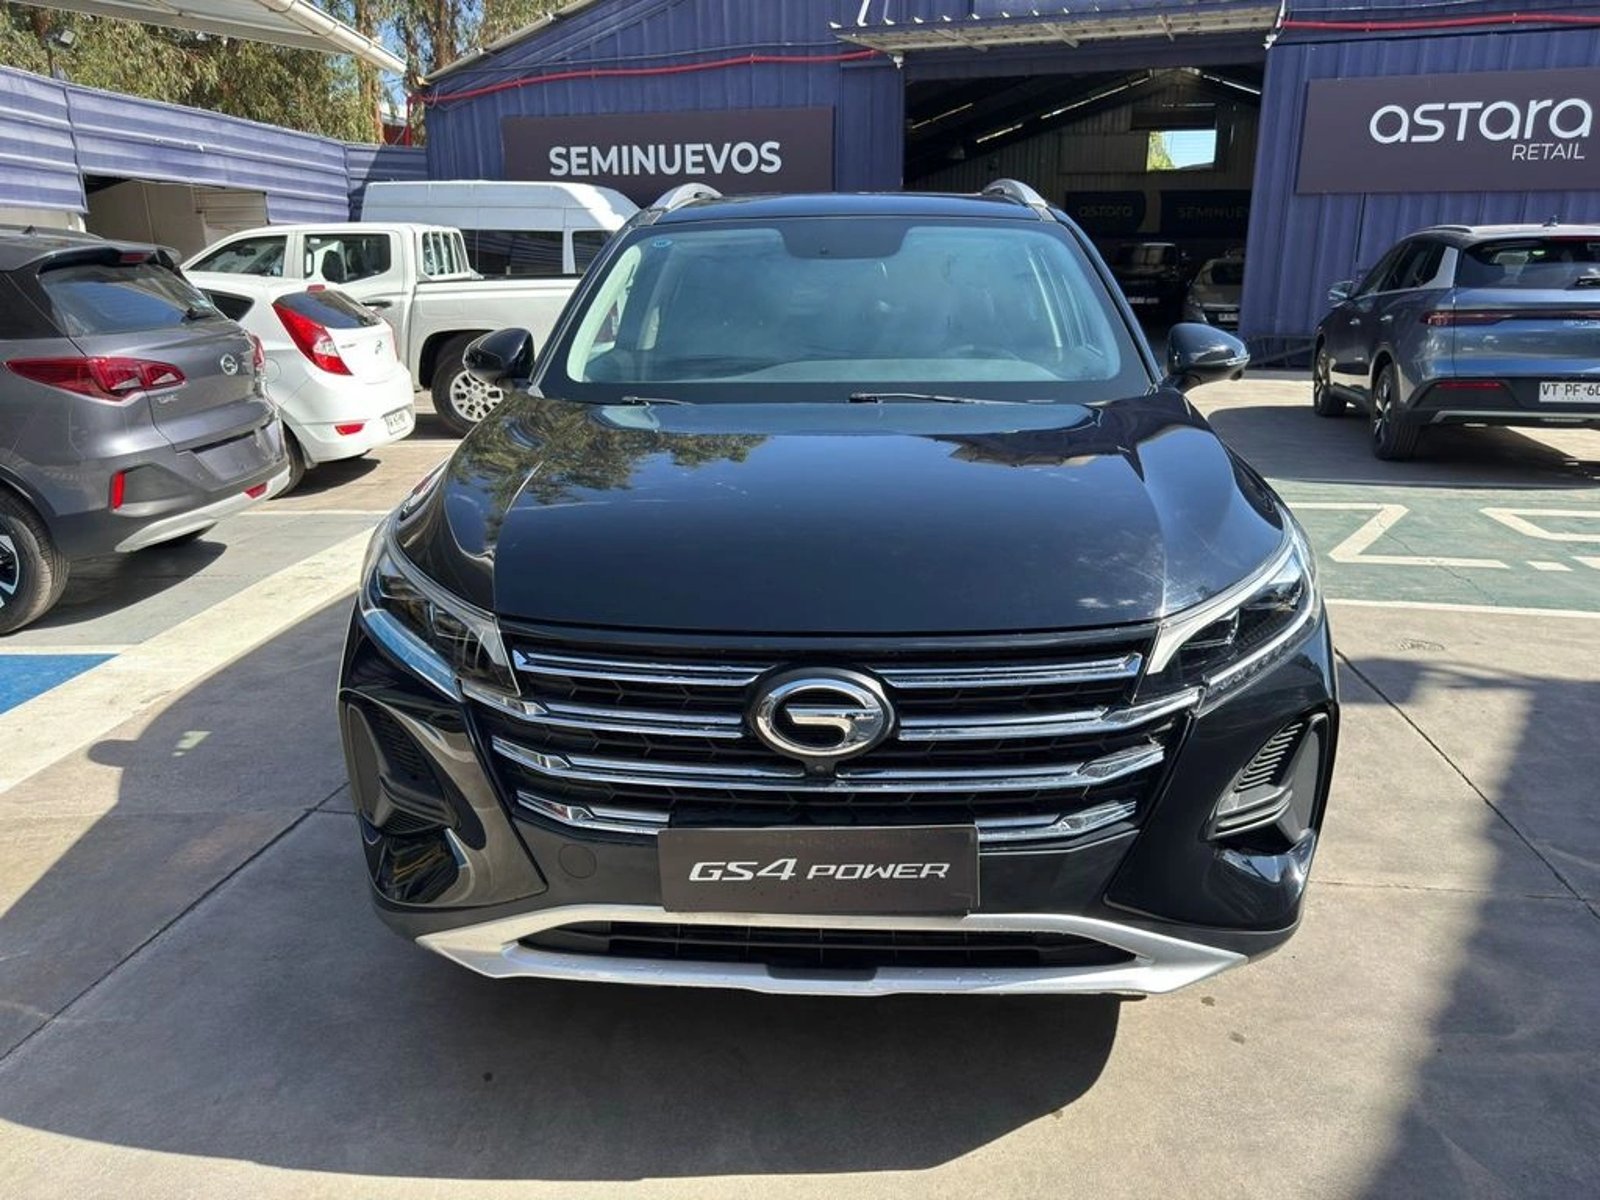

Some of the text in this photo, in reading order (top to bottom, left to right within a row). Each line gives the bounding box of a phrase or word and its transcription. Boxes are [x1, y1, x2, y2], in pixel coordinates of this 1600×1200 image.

[549, 141, 782, 176] SEMINUEVOS
[1511, 143, 1585, 161] RETAIL
[1176, 206, 1248, 219] SEMINUE
[689, 858, 950, 881] GS4 POWER
